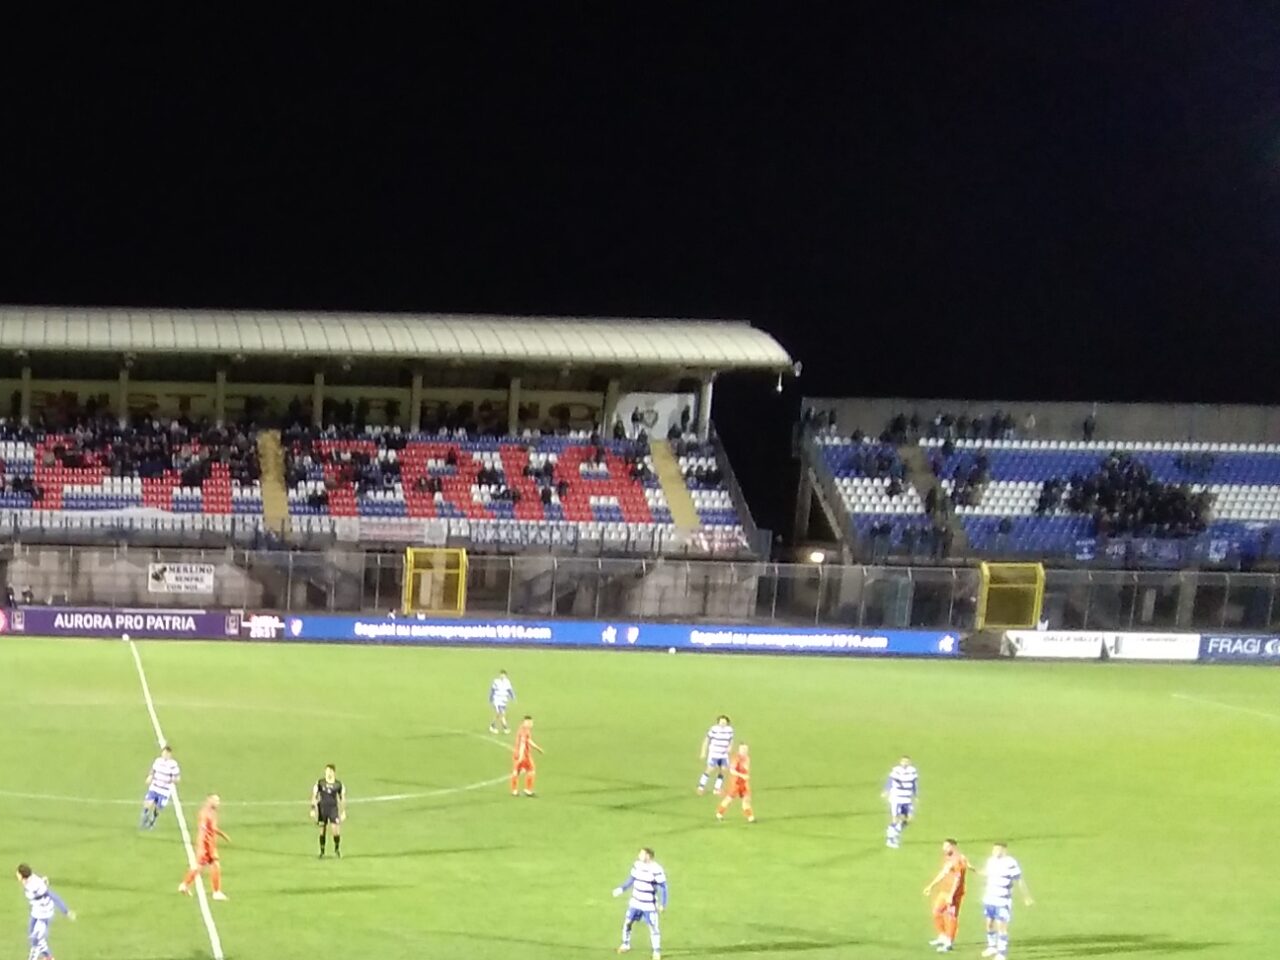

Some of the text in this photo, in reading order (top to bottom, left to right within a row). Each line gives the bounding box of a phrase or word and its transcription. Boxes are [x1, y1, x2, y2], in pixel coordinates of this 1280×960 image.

[54, 613, 196, 631] AURORA PRO PATRIA
[1207, 638, 1262, 654] FRAGI
